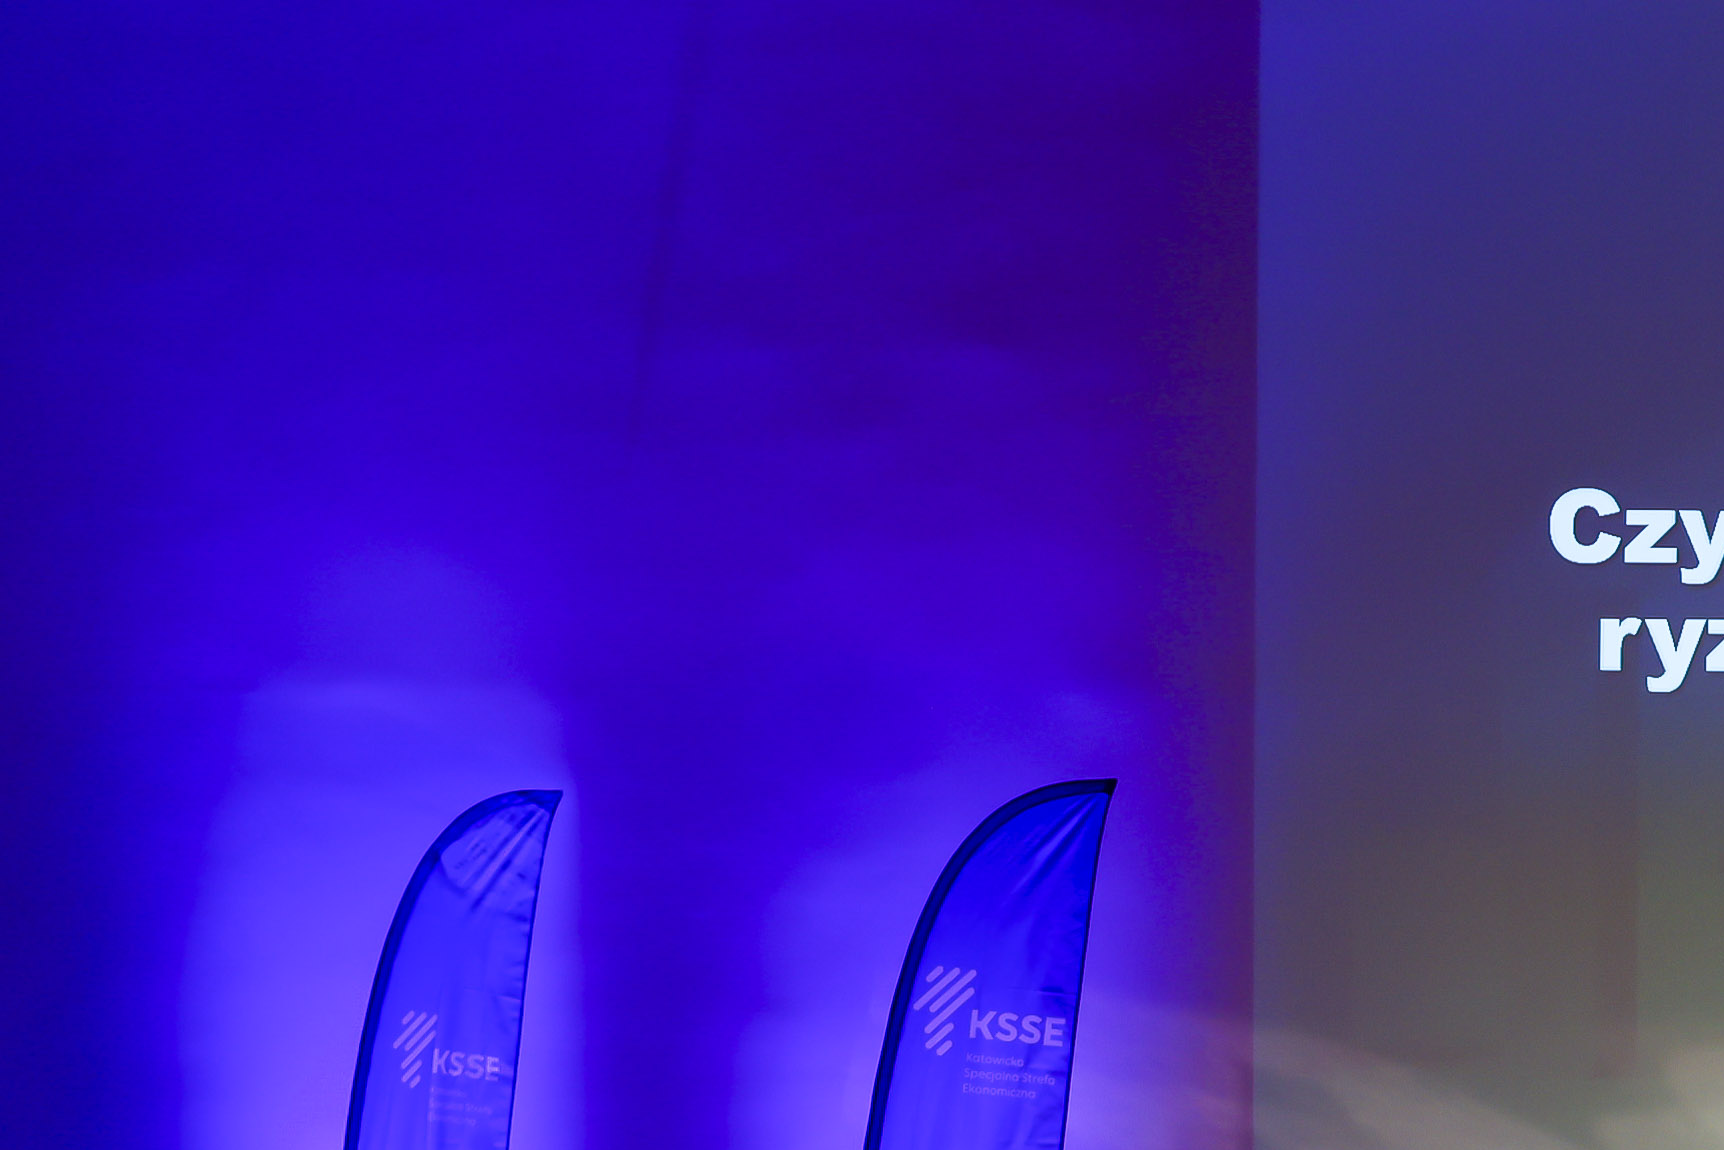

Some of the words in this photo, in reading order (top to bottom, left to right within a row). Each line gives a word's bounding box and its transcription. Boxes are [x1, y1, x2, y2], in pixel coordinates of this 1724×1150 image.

[969, 1009, 1067, 1048] KSSE
[432, 1048, 500, 1081] KSSE
[962, 1083, 1037, 1099] Ekonomiczna
